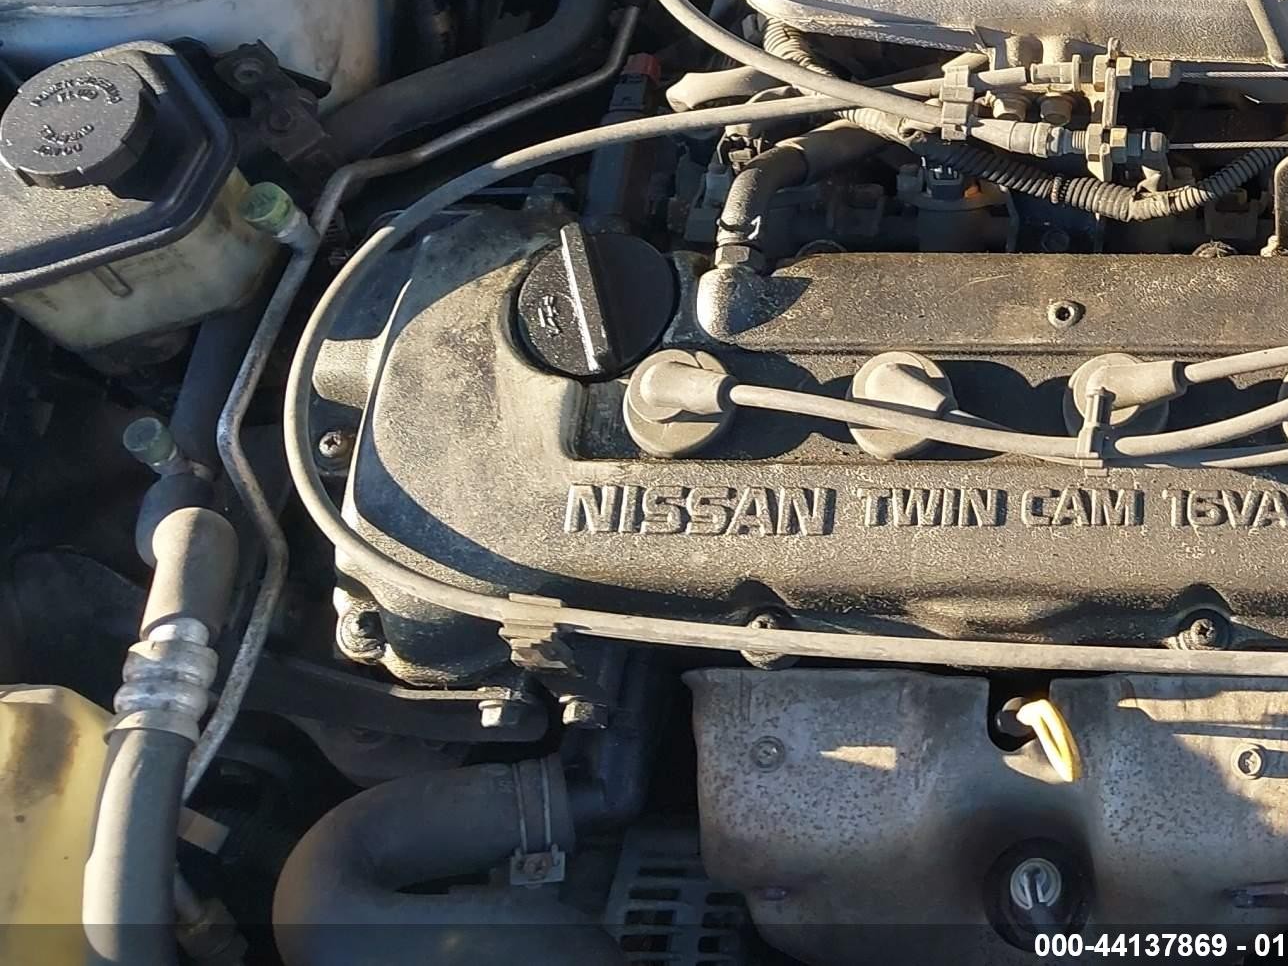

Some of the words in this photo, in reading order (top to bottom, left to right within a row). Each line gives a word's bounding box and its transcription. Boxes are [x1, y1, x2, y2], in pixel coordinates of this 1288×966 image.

[563, 483, 837, 536] NISSAN
[857, 485, 997, 529] TWIN
[1020, 487, 1146, 528] CAM
